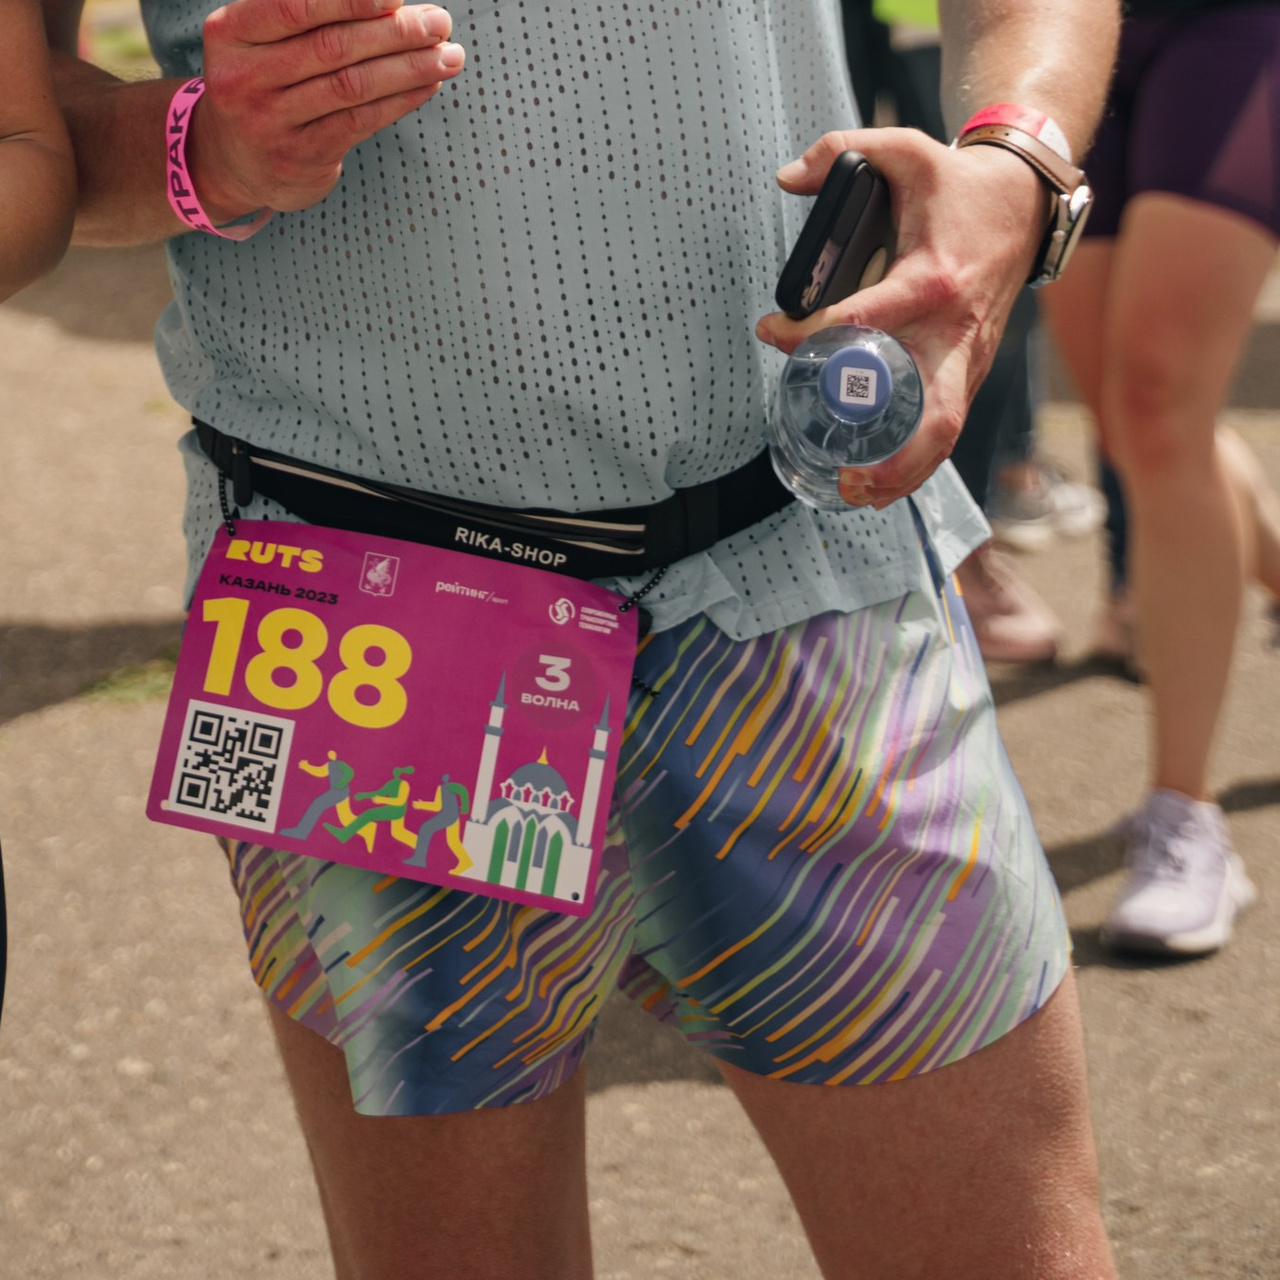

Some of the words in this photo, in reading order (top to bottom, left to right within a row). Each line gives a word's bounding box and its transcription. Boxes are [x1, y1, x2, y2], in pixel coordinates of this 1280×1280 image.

[225, 539, 324, 573] RUTS
[455, 527, 568, 568] RIKA-SHOP
[219, 574, 292, 597] КАЗАНЬ
[294, 587, 339, 605] 2023
[202, 597, 413, 729] 188
[534, 654, 572, 692] 3
[521, 692, 580, 712] ВОЛНА
